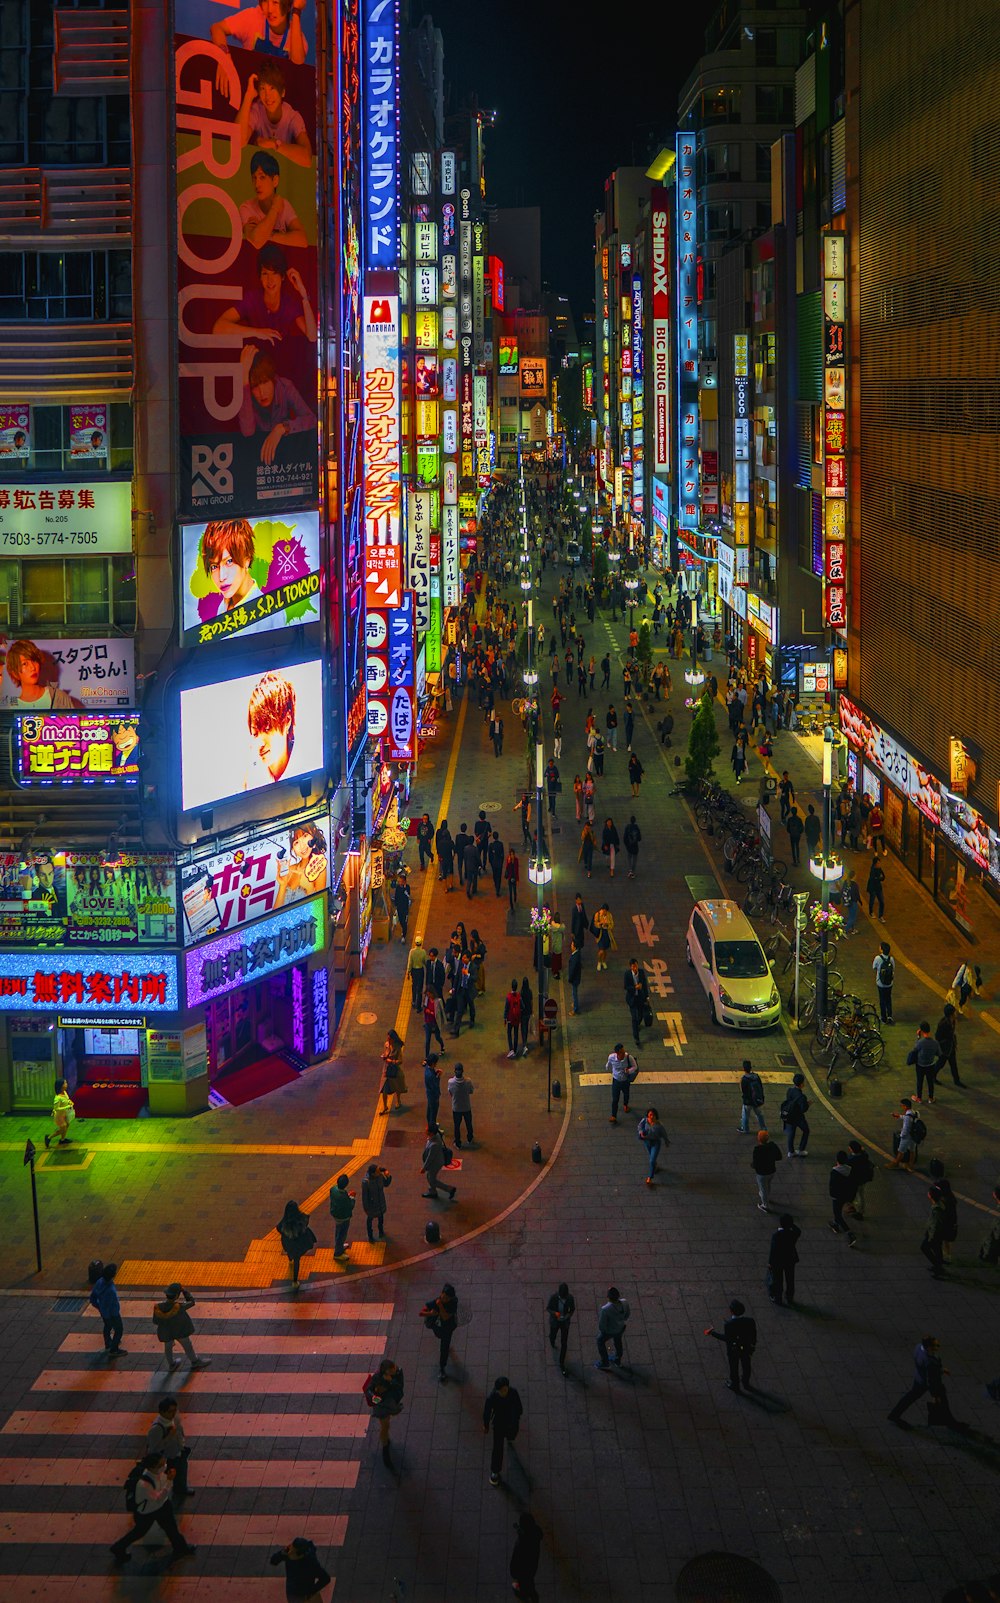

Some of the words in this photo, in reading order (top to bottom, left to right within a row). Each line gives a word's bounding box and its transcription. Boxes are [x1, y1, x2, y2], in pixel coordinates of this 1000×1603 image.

[369, 36, 395, 255] カラオケランド
[460, 188, 471, 219] Booth
[175, 39, 243, 421] GROUP
[421, 224, 431, 259] 川新ビル
[653, 211, 668, 296] SHIDAX
[682, 144, 695, 372] カラオケ&パーティー館
[421, 268, 431, 303] にいむら
[366, 324, 396, 333] MARUHAN
[656, 327, 666, 349] BIC
[461, 336, 472, 367] Booth
[656, 353, 666, 391] DRUG
[738, 384, 746, 414] COCO
[826, 421, 845, 448] 麻雀
[256, 462, 313, 476] 総合求人ダイヤル
[684, 413, 696, 514] カラオケ館
[191, 496, 209, 507] RAIN
[209, 495, 235, 505] GROUP
[45, 515, 69, 523] No.205
[2, 531, 98, 546] 7503-5774-7505
[370, 548, 396, 558] 오른쪽
[446, 539, 456, 581] ルノアール
[199, 608, 249, 644] 君の太陽
[283, 574, 320, 605] TOKYO
[52, 644, 108, 665] スタプロ
[78, 659, 128, 682] かもん!
[394, 694, 409, 743] たばこ
[29, 744, 114, 773] 逆ナン館
[69, 928, 122, 942] ここから30秒
[201, 915, 319, 993] 無料案内所
[32, 970, 168, 1004] 無料案内所
[291, 966, 305, 1055] 無料案内所
[312, 967, 330, 1056] 無料案内所
